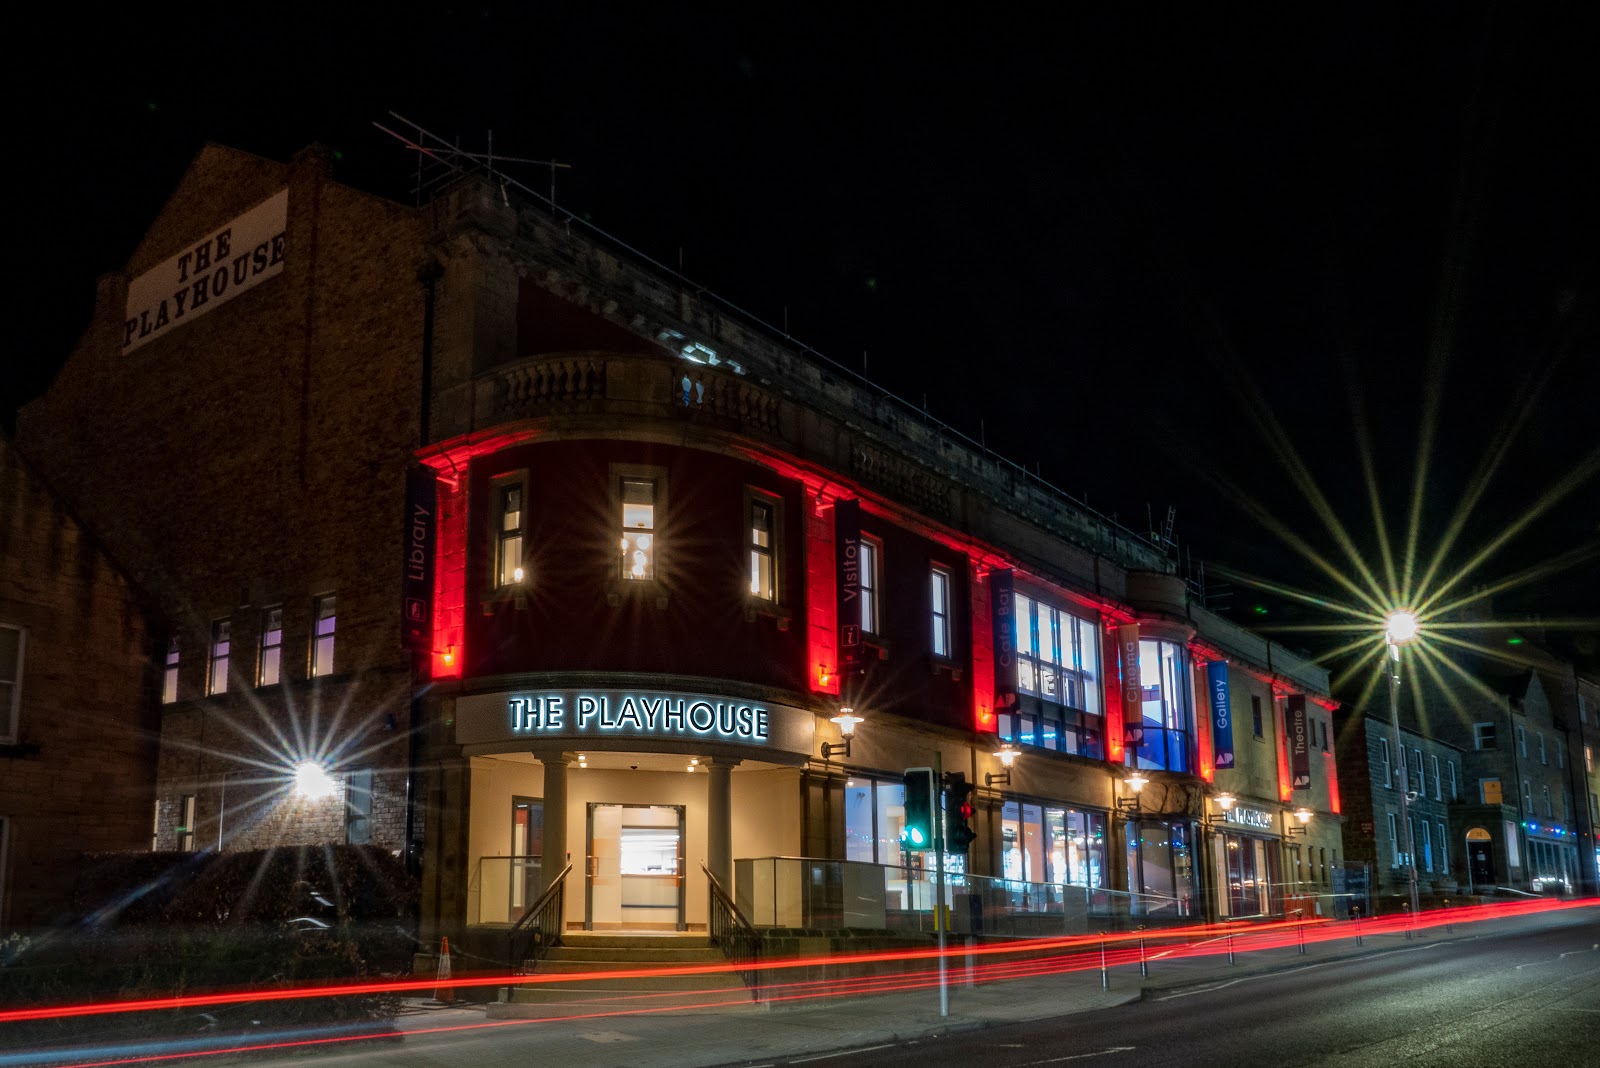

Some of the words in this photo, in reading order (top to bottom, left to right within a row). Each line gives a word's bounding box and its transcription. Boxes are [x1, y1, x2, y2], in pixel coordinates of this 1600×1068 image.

[178, 228, 231, 283] THE
[123, 230, 286, 348] PLAYHOUSE
[408, 504, 430, 581] Library
[843, 538, 857, 602] Visitor
[1126, 642, 1138, 702] Cinema
[508, 697, 563, 729] THE
[578, 697, 769, 739] PLAYHOUSE
[1216, 679, 1228, 729] Gallery
[1294, 710, 1305, 755] Theatre
